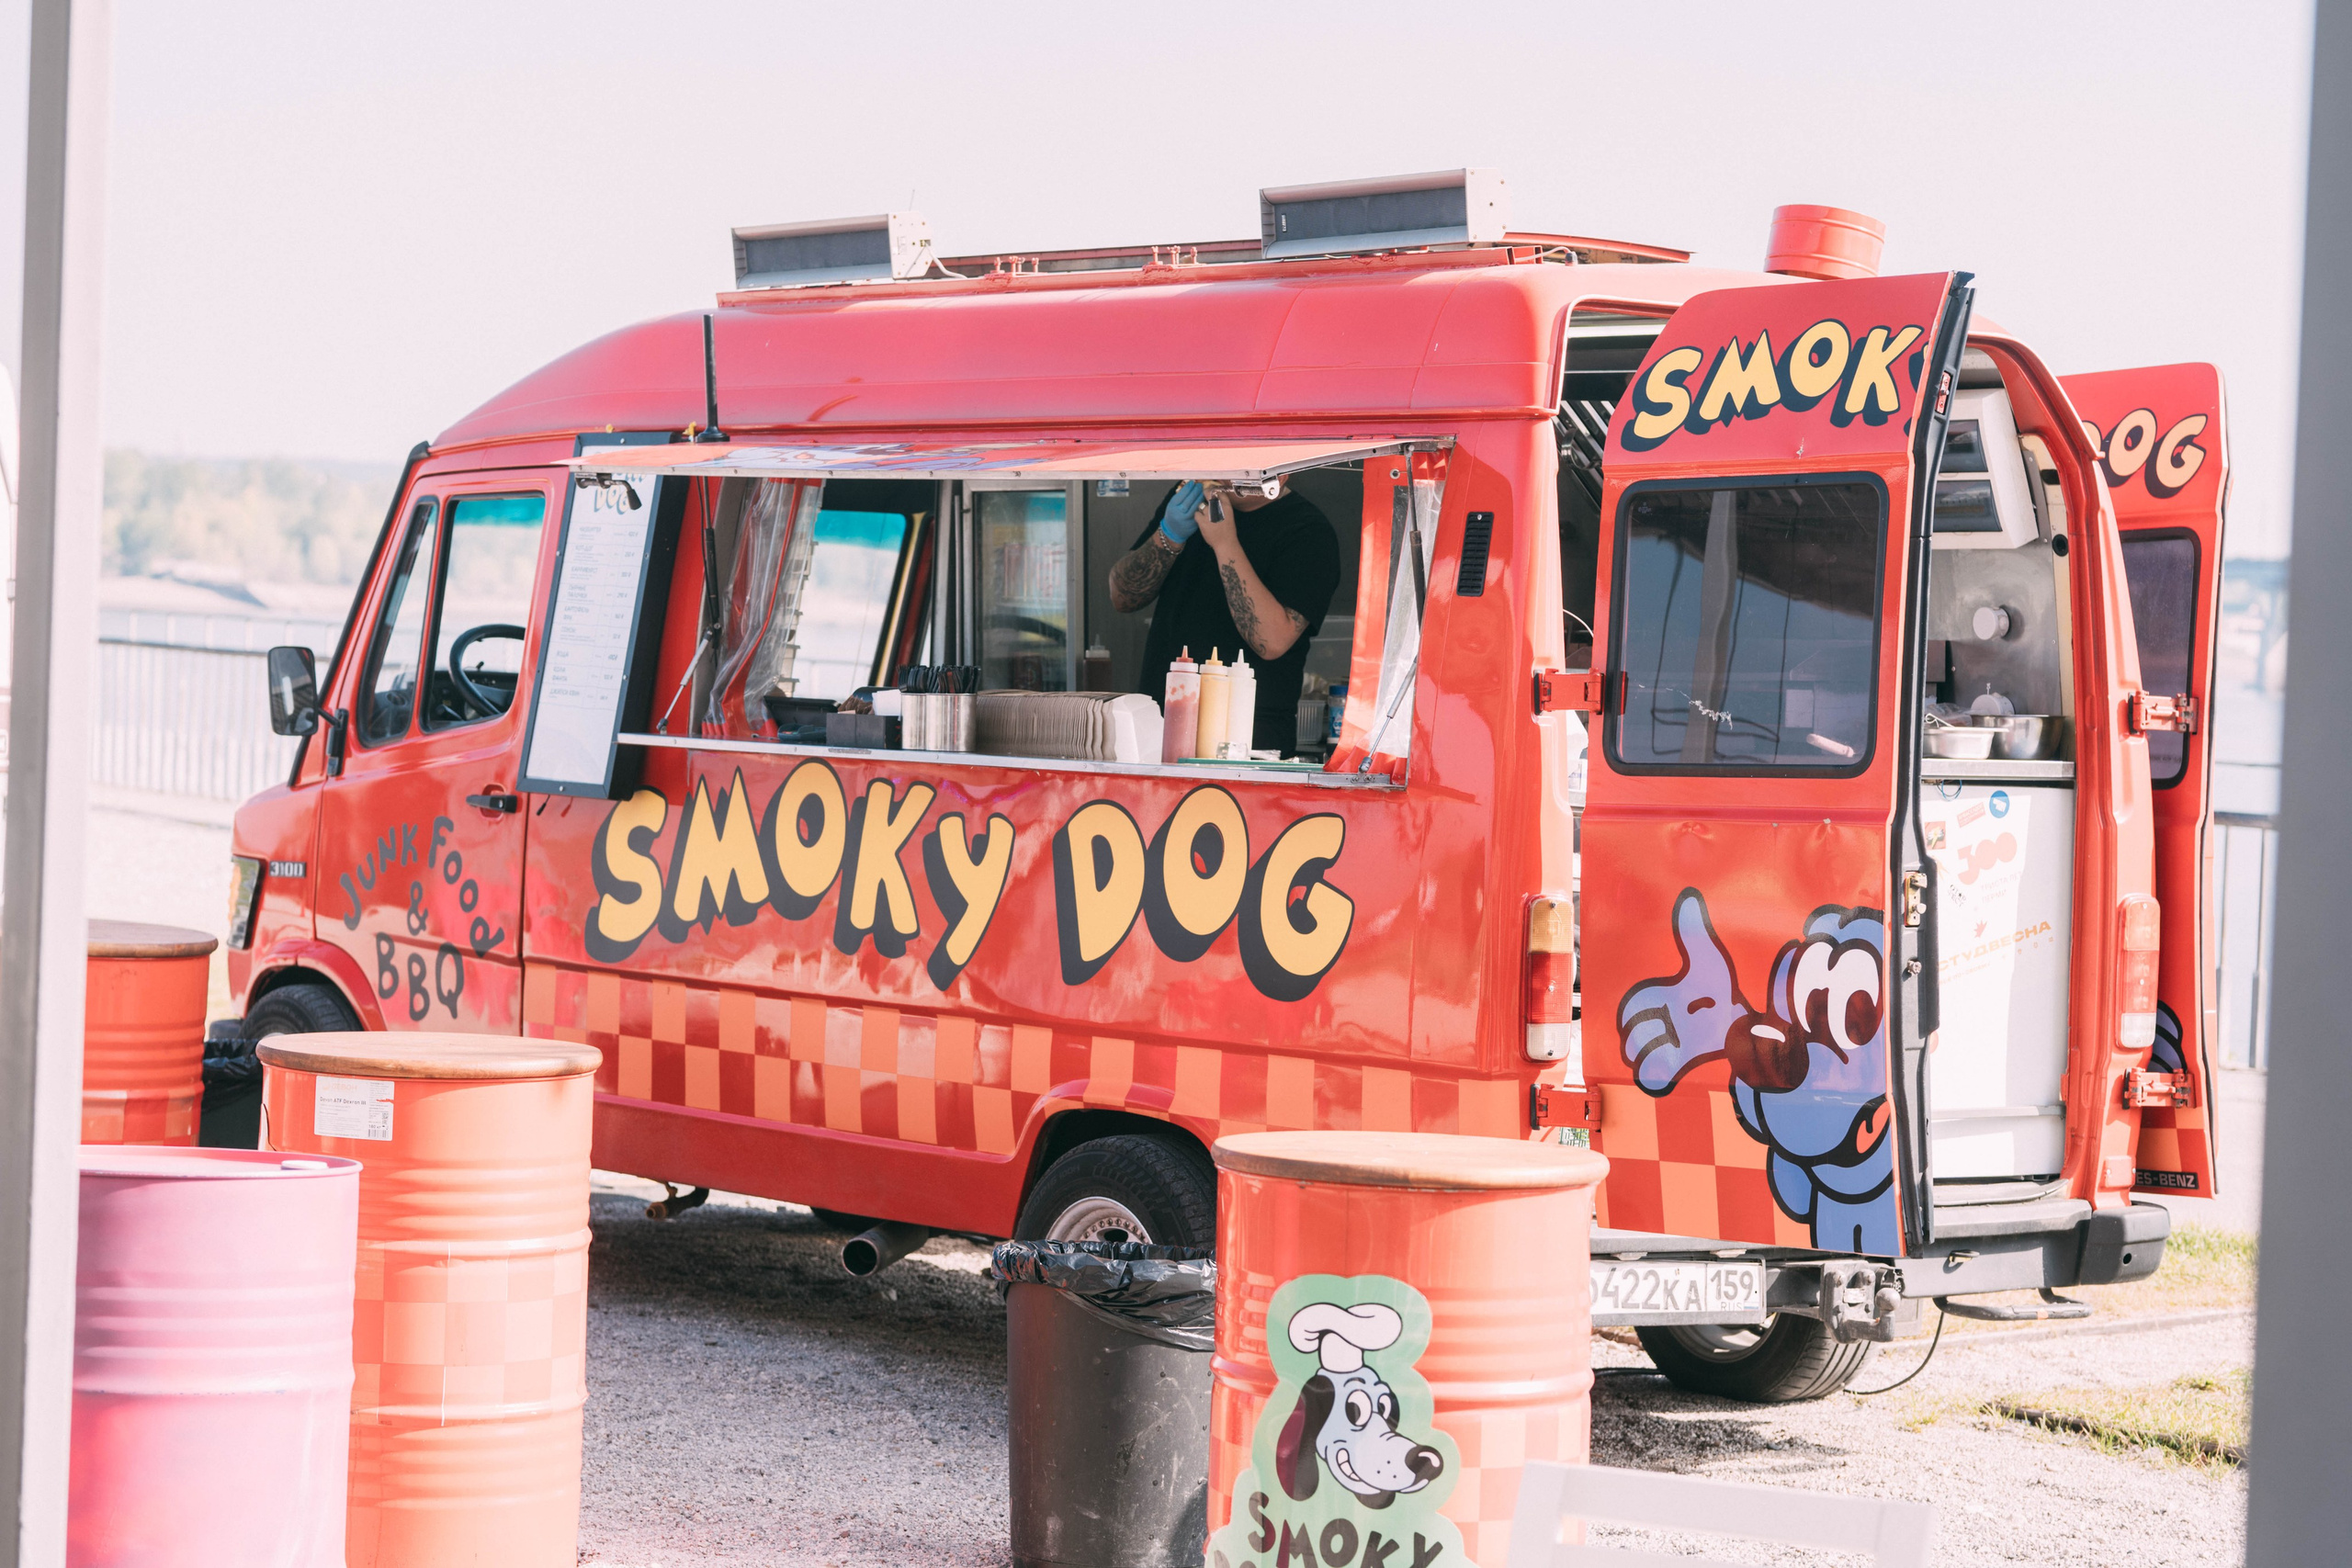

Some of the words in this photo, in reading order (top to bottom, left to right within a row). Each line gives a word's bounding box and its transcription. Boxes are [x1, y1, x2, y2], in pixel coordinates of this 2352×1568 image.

[1621, 319, 1930, 452] SMOK
[340, 823, 418, 931] JUNK
[585, 756, 1014, 992] SMOKY
[1053, 784, 1354, 1001] DOG
[1957, 831, 2018, 886] 300
[407, 881, 428, 935] &
[1939, 920, 2052, 972] СТУДВЕСНА
[376, 931, 464, 1021] BBQ
[1710, 1269, 1754, 1302] 159
[1247, 1490, 1444, 1568] SMOKY
